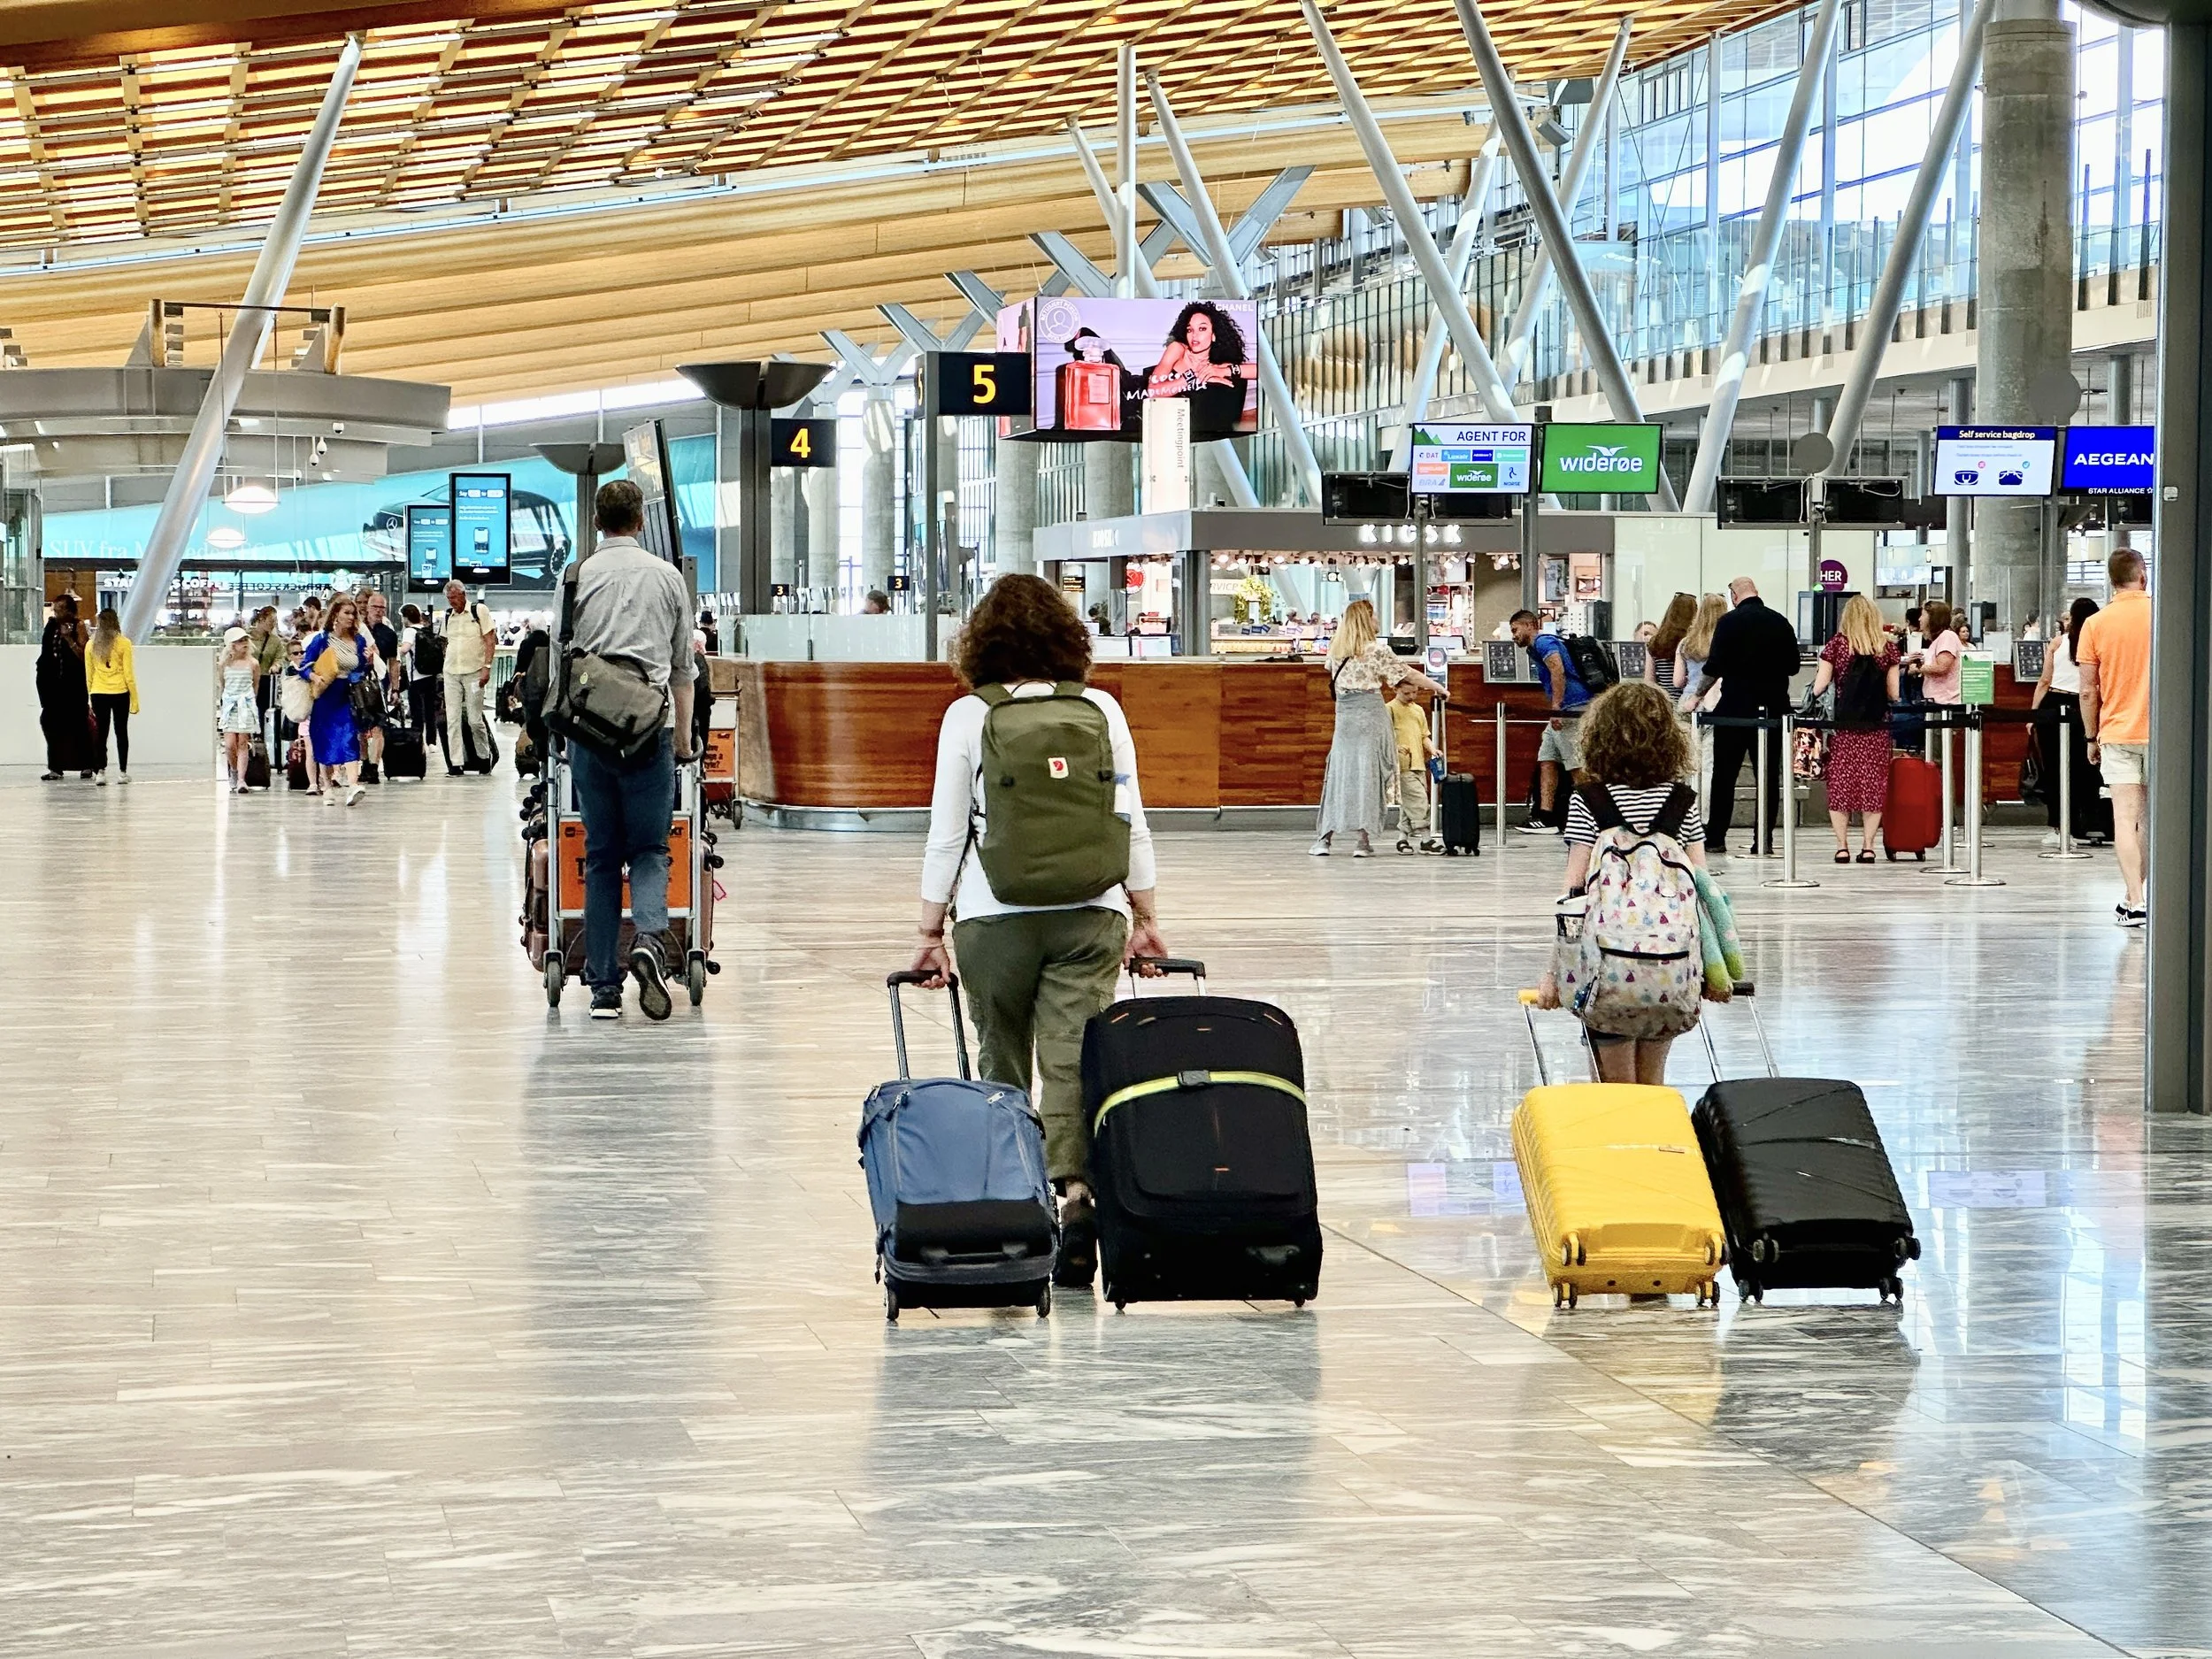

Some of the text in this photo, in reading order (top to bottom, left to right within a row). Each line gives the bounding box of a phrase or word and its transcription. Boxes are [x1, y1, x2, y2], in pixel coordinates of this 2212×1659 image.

[1215, 303, 1254, 312] CHANEL
[972, 364, 996, 404] 5
[1175, 408, 1186, 468] Meetingpoint
[1456, 431, 1526, 442] AGENT FOR
[1959, 430, 2036, 440] Self service bagdrop
[790, 427, 811, 458] 4
[1559, 452, 1643, 472] widerøe
[2073, 452, 2155, 466] AEGEAN
[50, 539, 95, 558] SUV
[1820, 570, 1843, 581] HER
[777, 585, 784, 595] 3
[895, 579, 903, 589] 3
